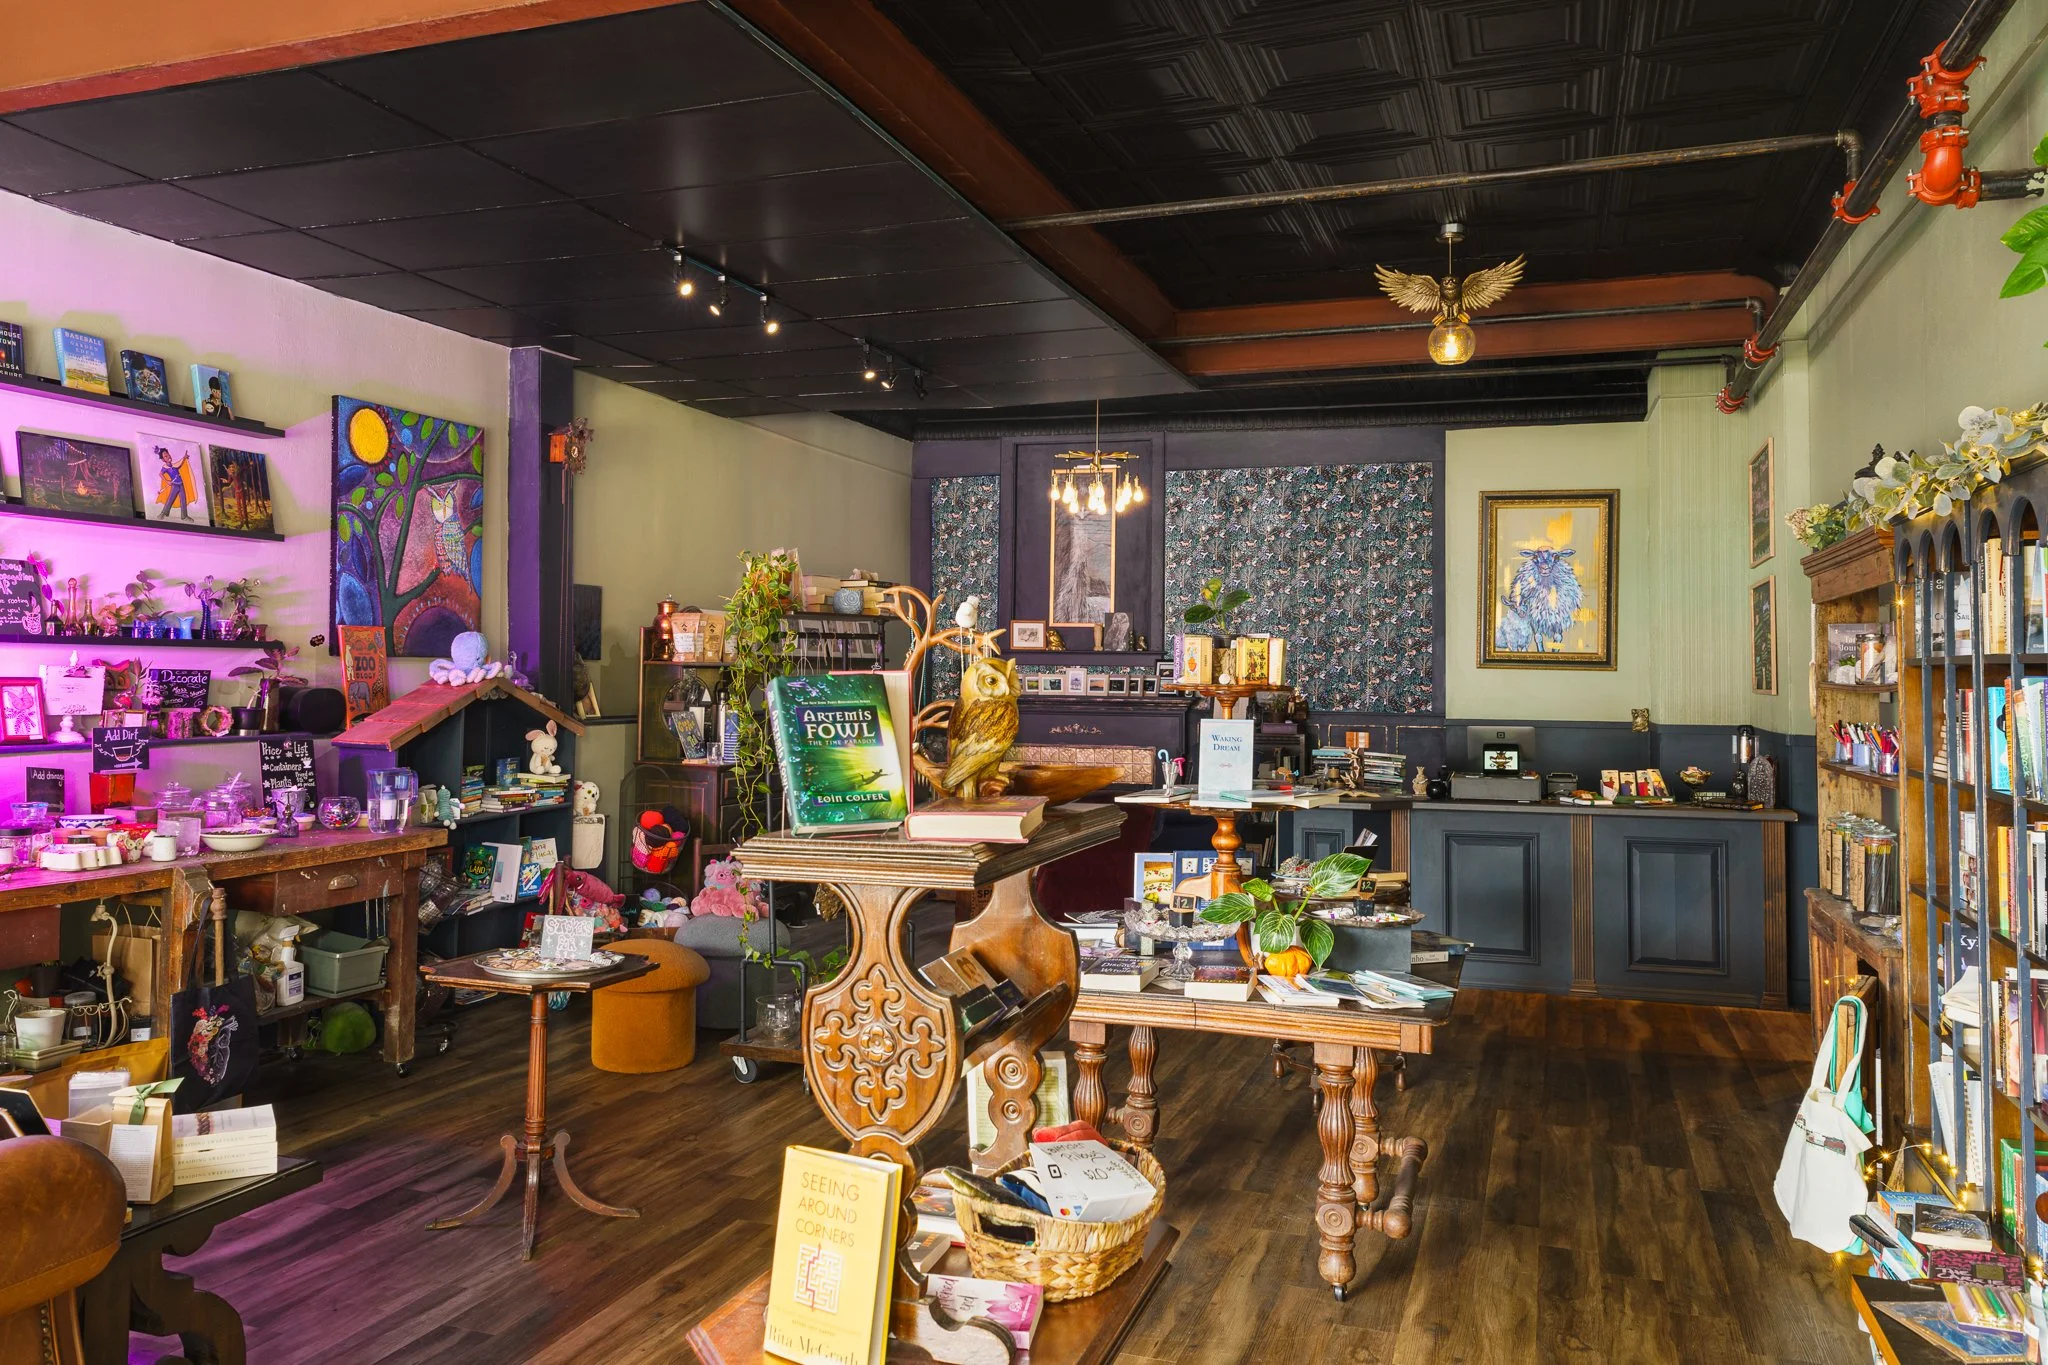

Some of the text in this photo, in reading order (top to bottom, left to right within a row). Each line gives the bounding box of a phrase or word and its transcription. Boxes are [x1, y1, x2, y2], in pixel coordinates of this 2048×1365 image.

[354, 656, 376, 671] ZOO
[161, 669, 208, 684] Decorate
[104, 728, 140, 742] Add Dirt
[806, 722, 875, 739] FOWL
[261, 741, 308, 757] Price List
[270, 761, 302, 772] Containers
[32, 769, 46, 780] Add
[270, 776, 293, 789] Plants
[845, 793, 888, 802] COLFER
[469, 864, 487, 875] LAND
[1361, 881, 1373, 890] $2
[1174, 899, 1189, 909] $2
[801, 1171, 860, 1202] SEEING
[798, 1196, 858, 1225] AROUND
[795, 1218, 856, 1248] CORNERS
[768, 1323, 793, 1350] Rita
